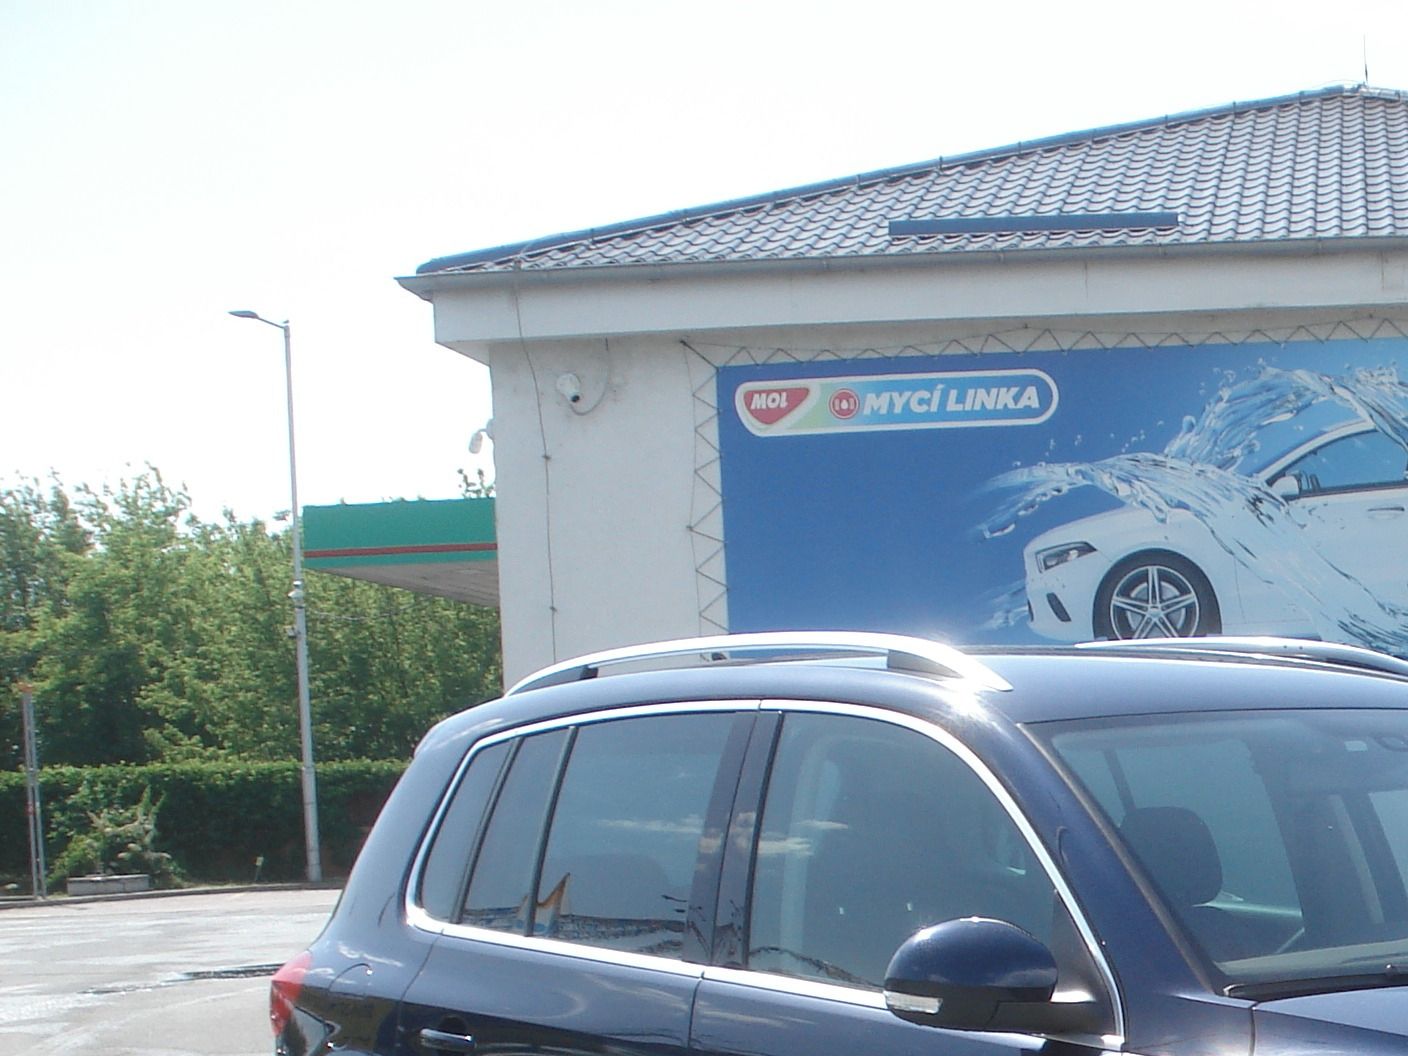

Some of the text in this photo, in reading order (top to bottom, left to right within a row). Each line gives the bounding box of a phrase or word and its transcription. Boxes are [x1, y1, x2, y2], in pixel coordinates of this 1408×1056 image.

[750, 392, 788, 410] MOL
[863, 384, 1040, 415] MYCÍ LINKA
